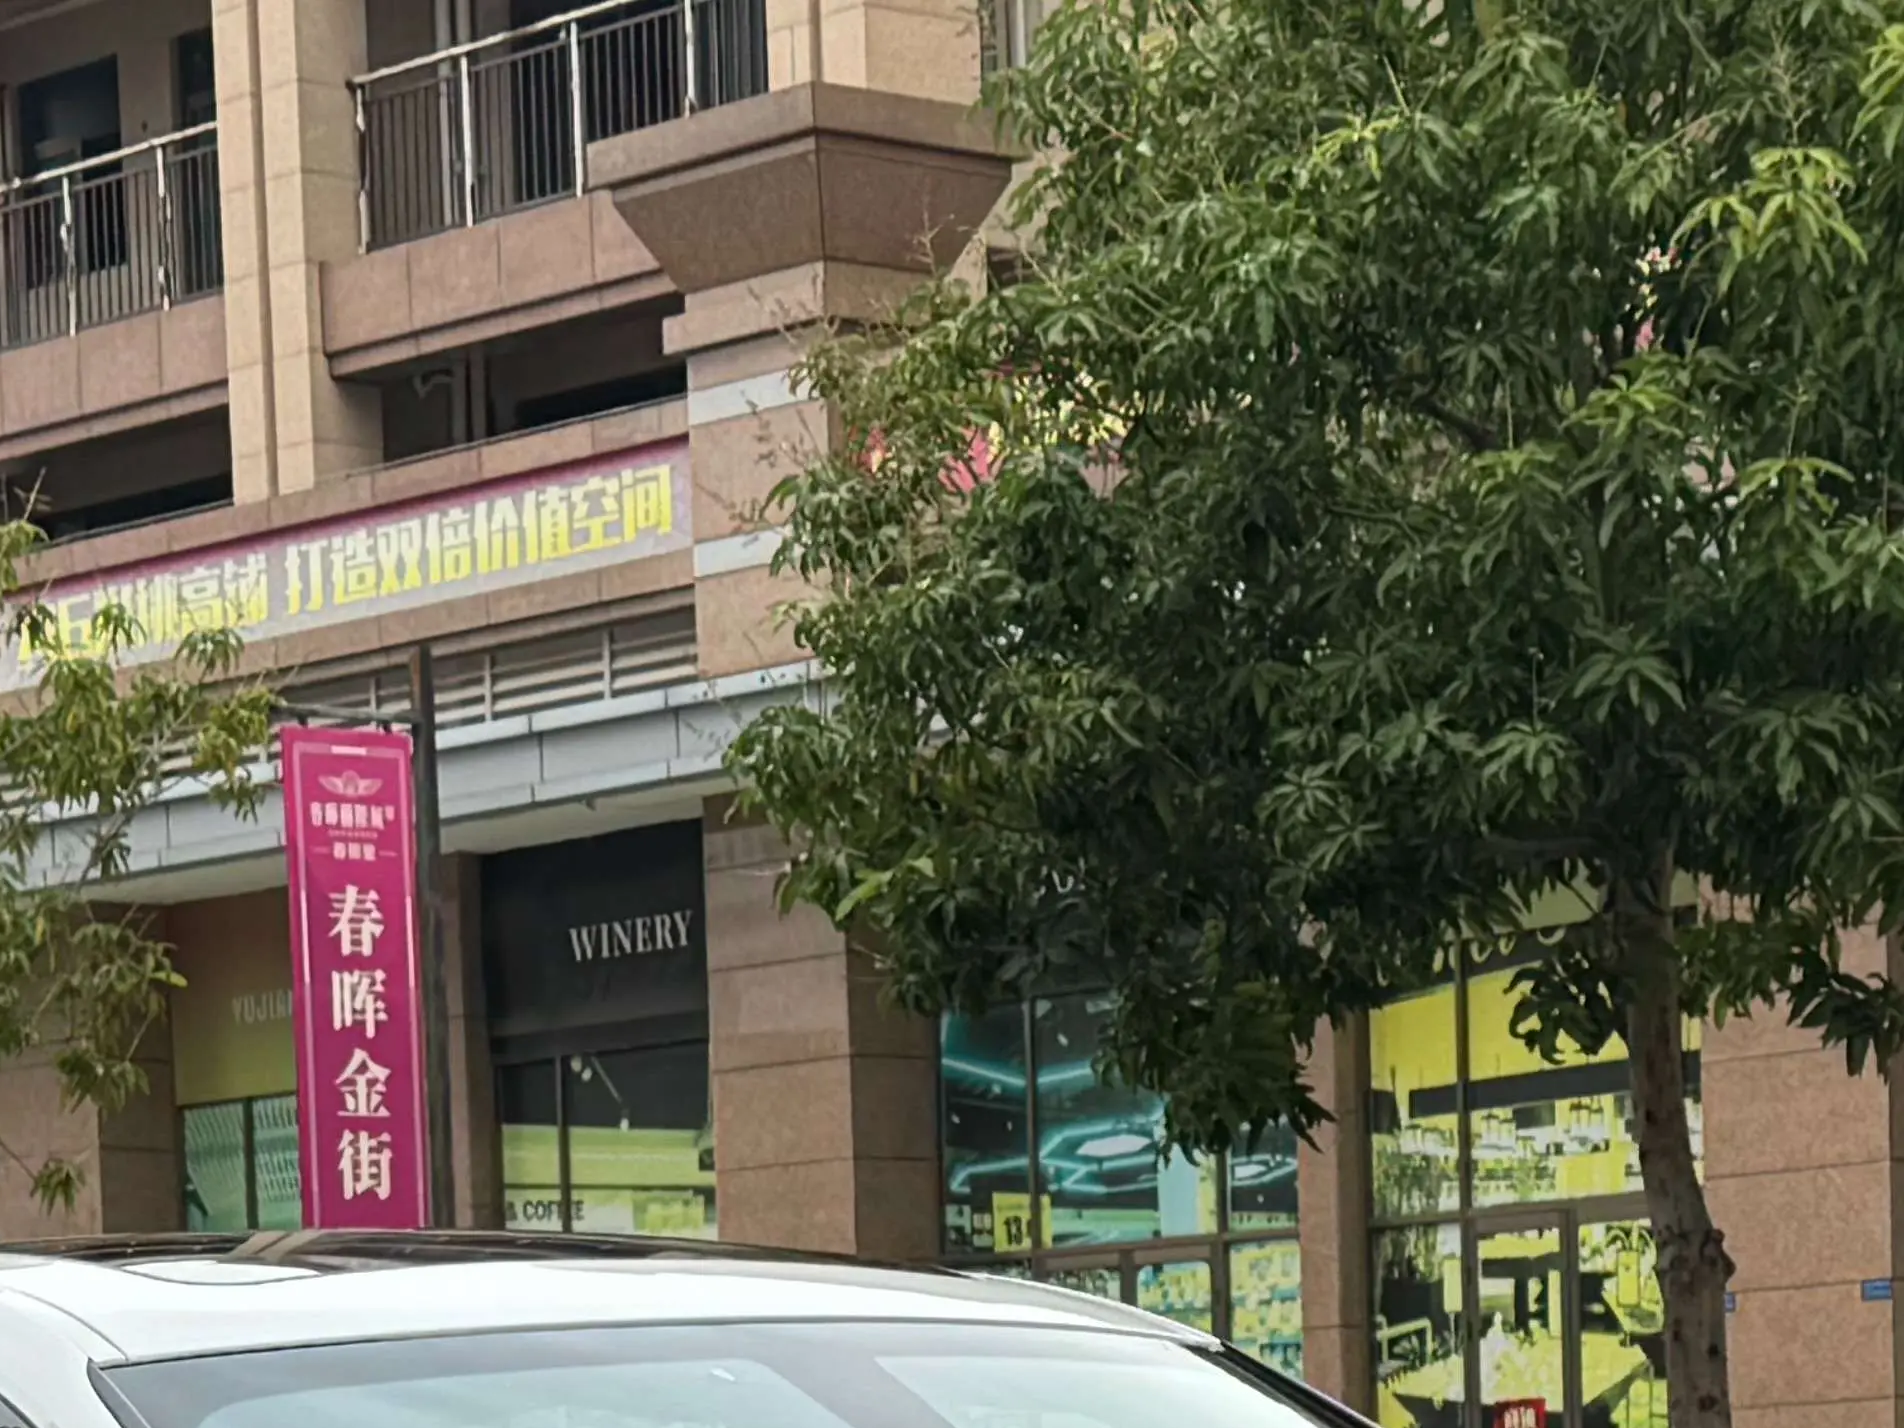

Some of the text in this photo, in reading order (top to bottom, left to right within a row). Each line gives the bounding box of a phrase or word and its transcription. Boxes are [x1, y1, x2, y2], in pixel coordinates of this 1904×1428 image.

[285, 464, 673, 615] 打造双倍价值空间
[568, 908, 693, 963] WINERY
[328, 884, 393, 1201] 春晖金街
